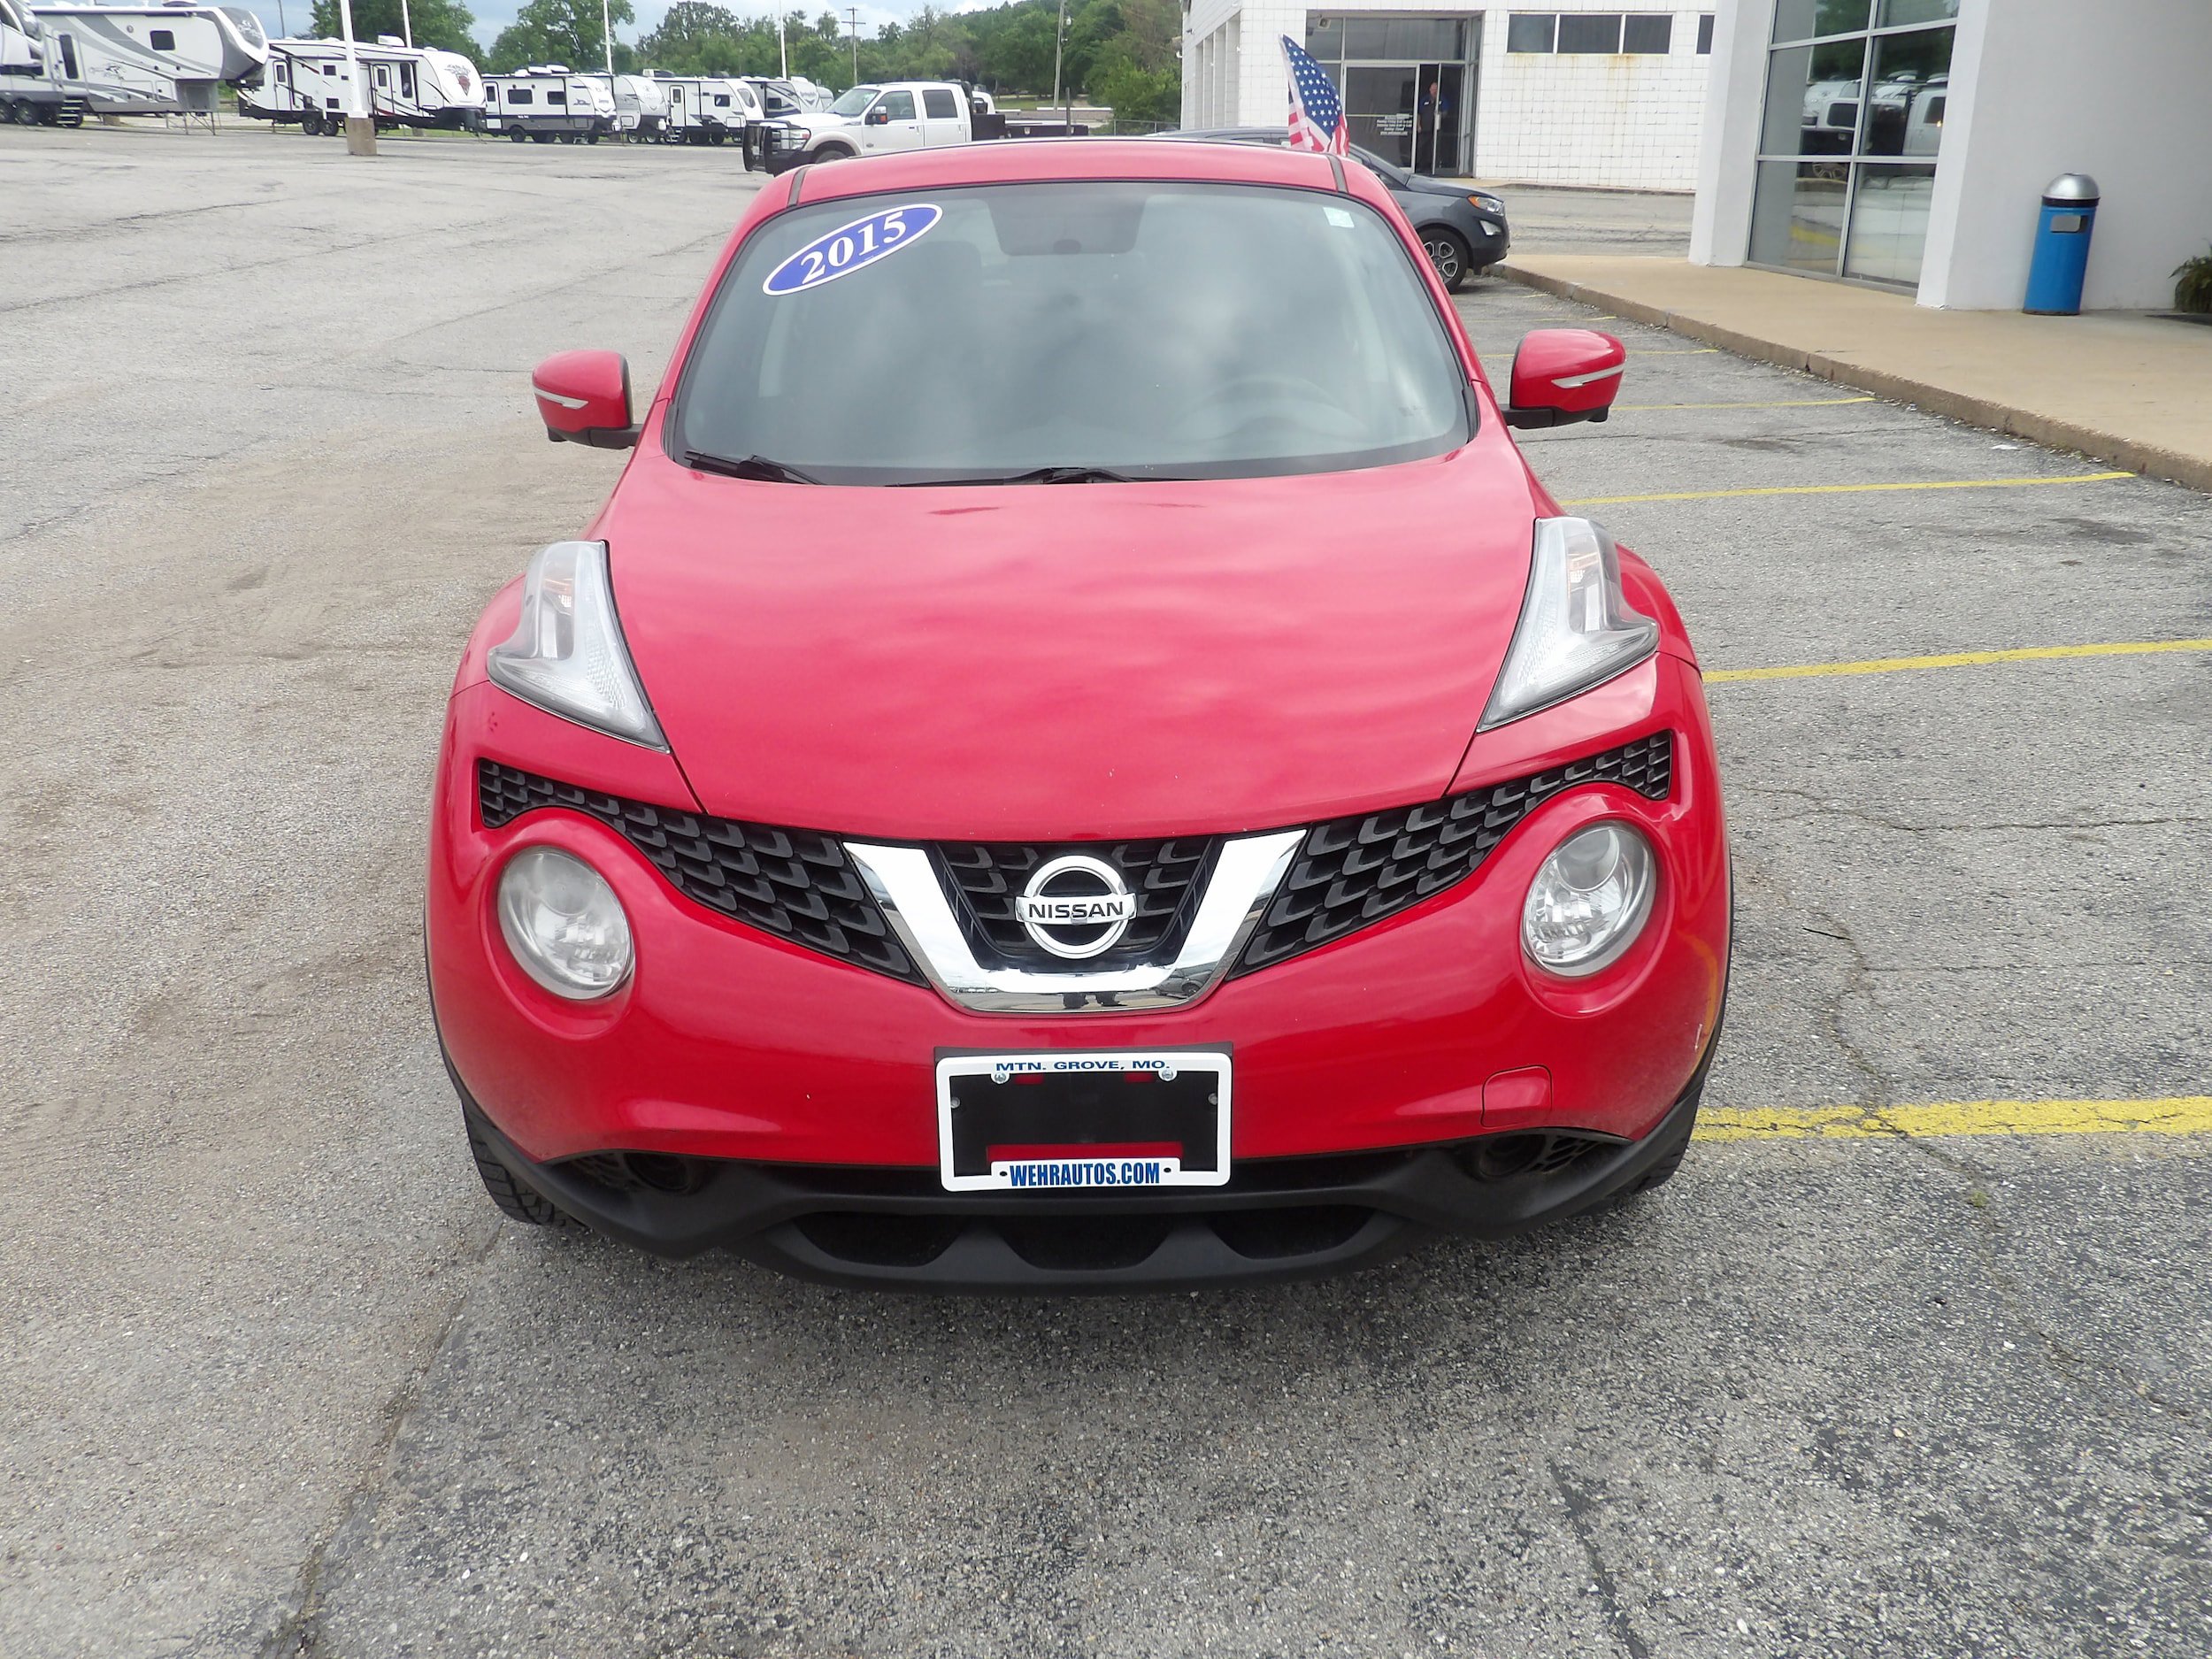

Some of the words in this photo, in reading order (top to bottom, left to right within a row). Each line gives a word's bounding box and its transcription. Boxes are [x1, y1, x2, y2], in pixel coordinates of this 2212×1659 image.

[800, 211, 907, 285] 2015
[1028, 901, 1124, 919] NISSAN
[995, 1062, 1047, 1071] MTN.
[1053, 1060, 1125, 1071] GROVE,
[1132, 1059, 1171, 1070] MO.
[1010, 1162, 1160, 1187] WEHRAUTOS.COM
